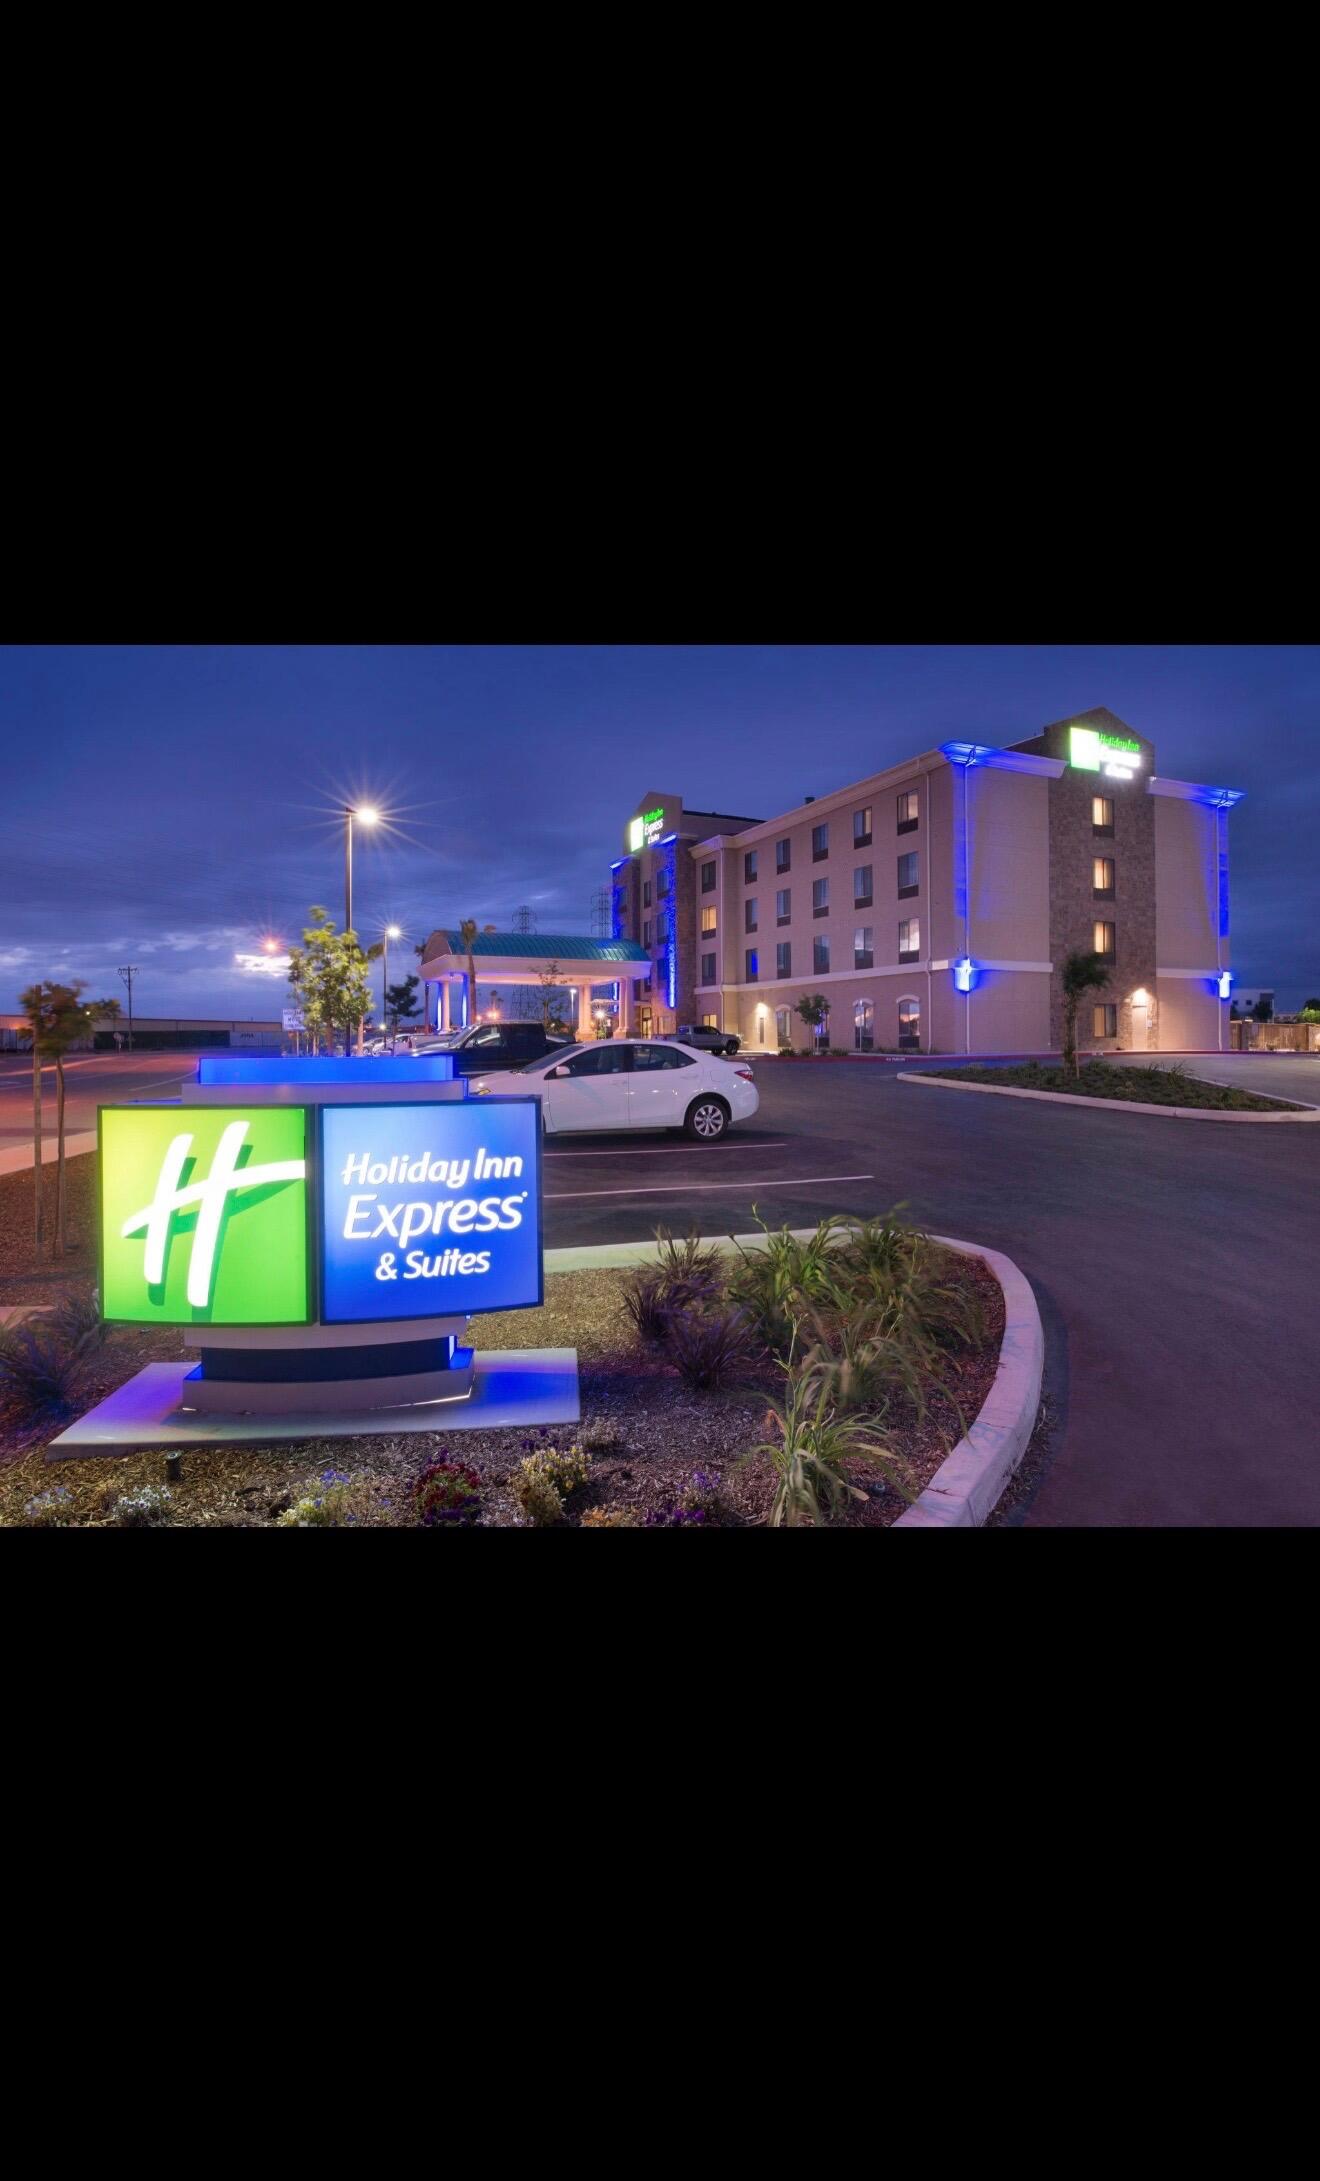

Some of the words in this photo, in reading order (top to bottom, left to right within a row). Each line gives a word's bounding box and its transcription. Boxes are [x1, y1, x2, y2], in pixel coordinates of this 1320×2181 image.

[341, 1151, 471, 1189] Holiday
[473, 1148, 523, 1180] Inn
[343, 1194, 525, 1249] Express
[375, 1252, 398, 1281] &
[403, 1248, 491, 1279] Suites
